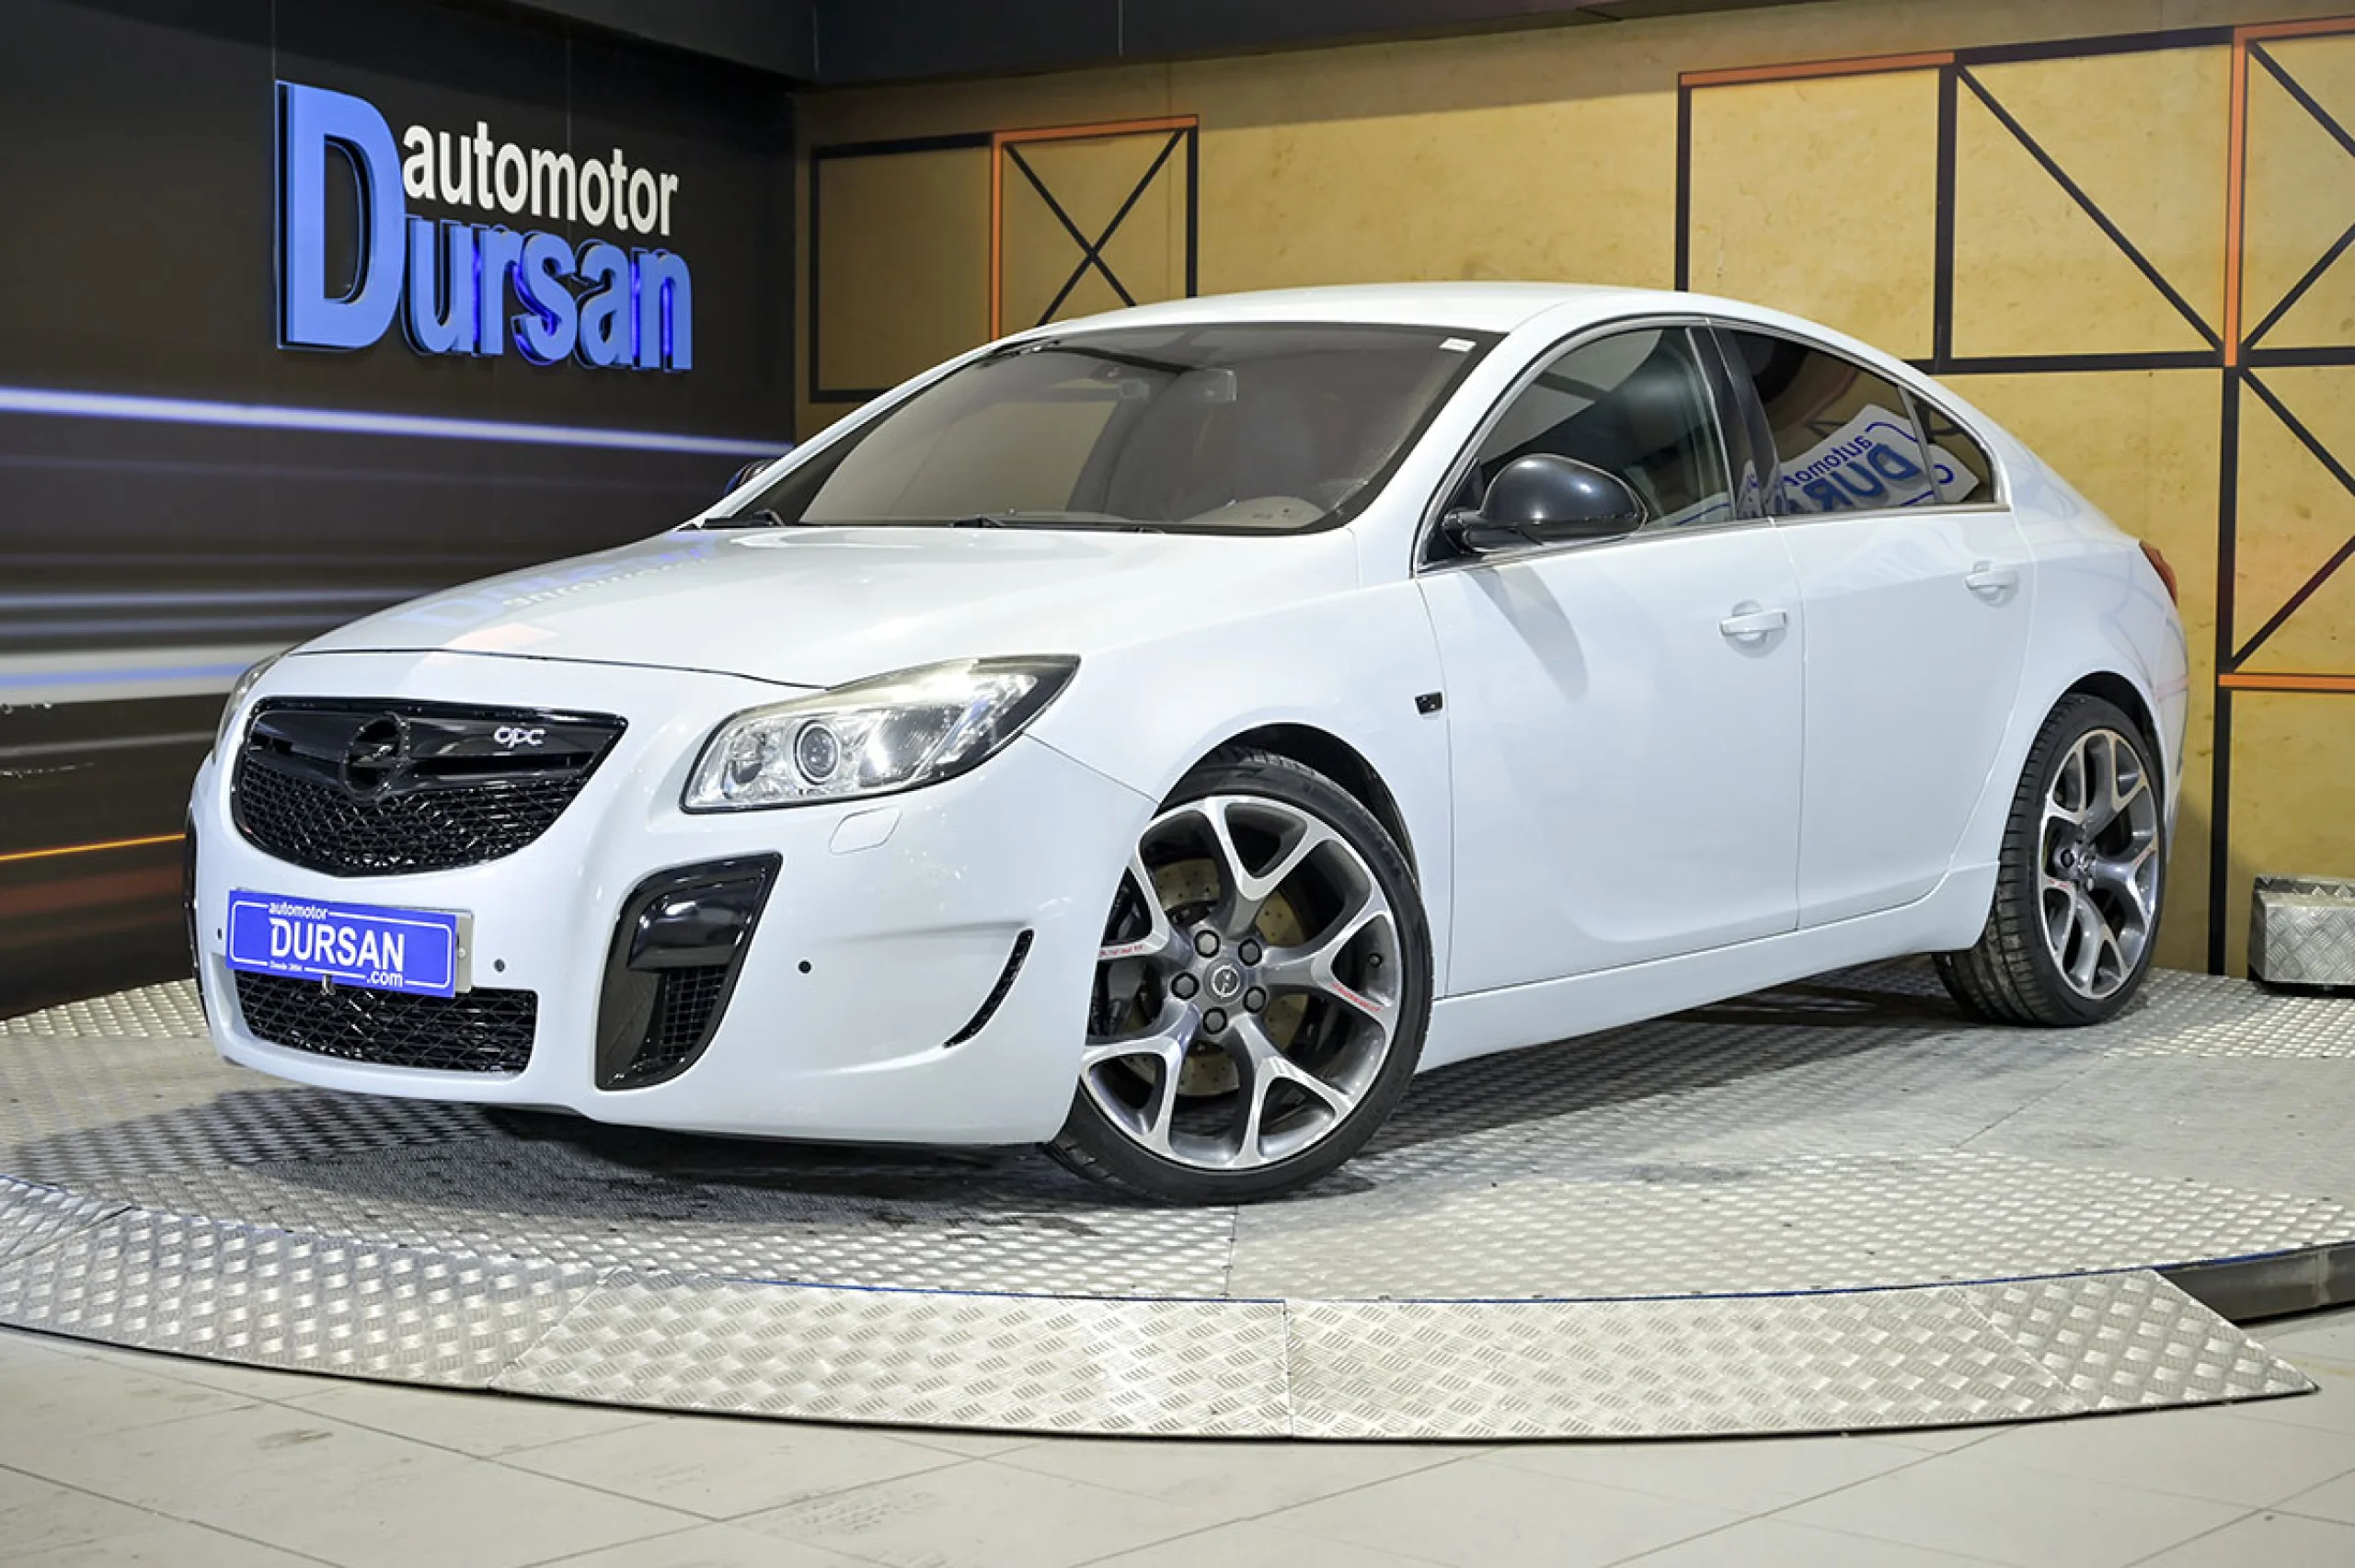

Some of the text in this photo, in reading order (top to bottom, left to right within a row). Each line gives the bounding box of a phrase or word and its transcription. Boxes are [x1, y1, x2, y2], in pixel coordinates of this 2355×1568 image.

[402, 121, 679, 235] automotor
[275, 79, 692, 372] Dursan
[269, 901, 328, 921] automotor
[269, 918, 405, 972] DURSAN
[366, 970, 404, 988] .com
